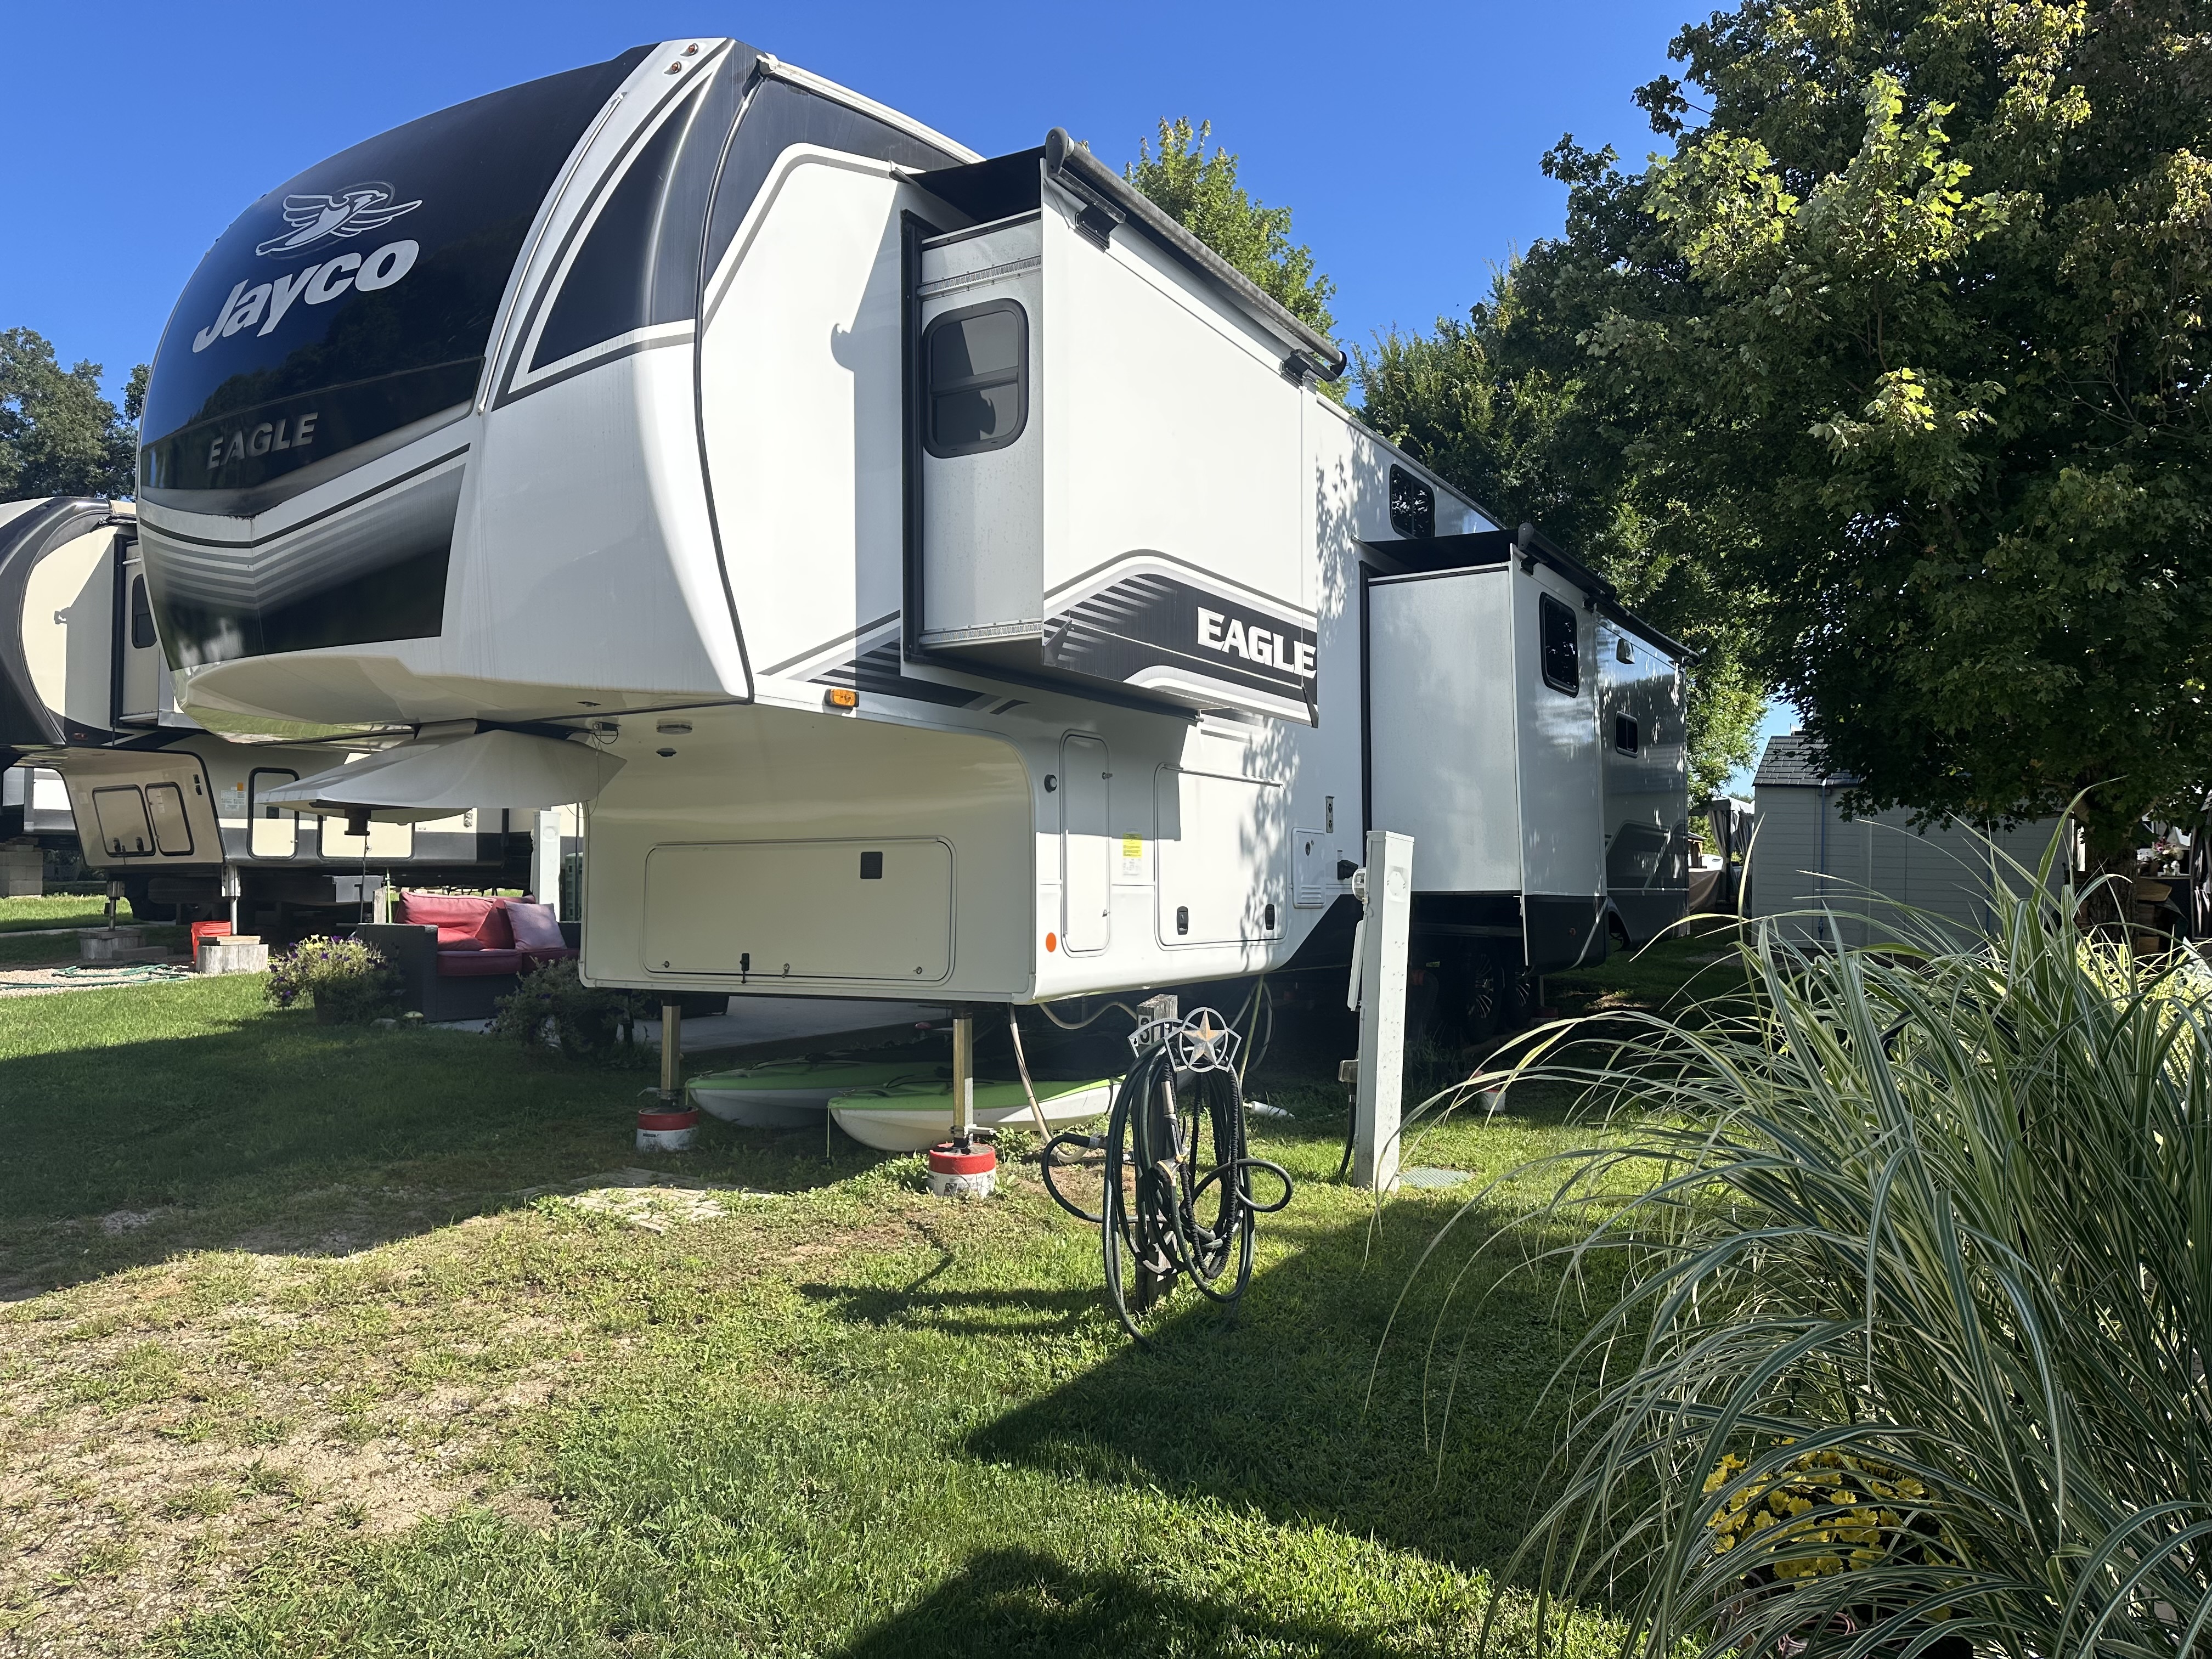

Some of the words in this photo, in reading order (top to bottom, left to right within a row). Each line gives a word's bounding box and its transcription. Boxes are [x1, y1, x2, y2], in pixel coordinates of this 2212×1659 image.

[193, 239, 419, 353] Jayco
[206, 412, 318, 470] EAGLE
[1197, 606, 1317, 679] EAGLE
[1140, 1017, 1150, 1043] 3
